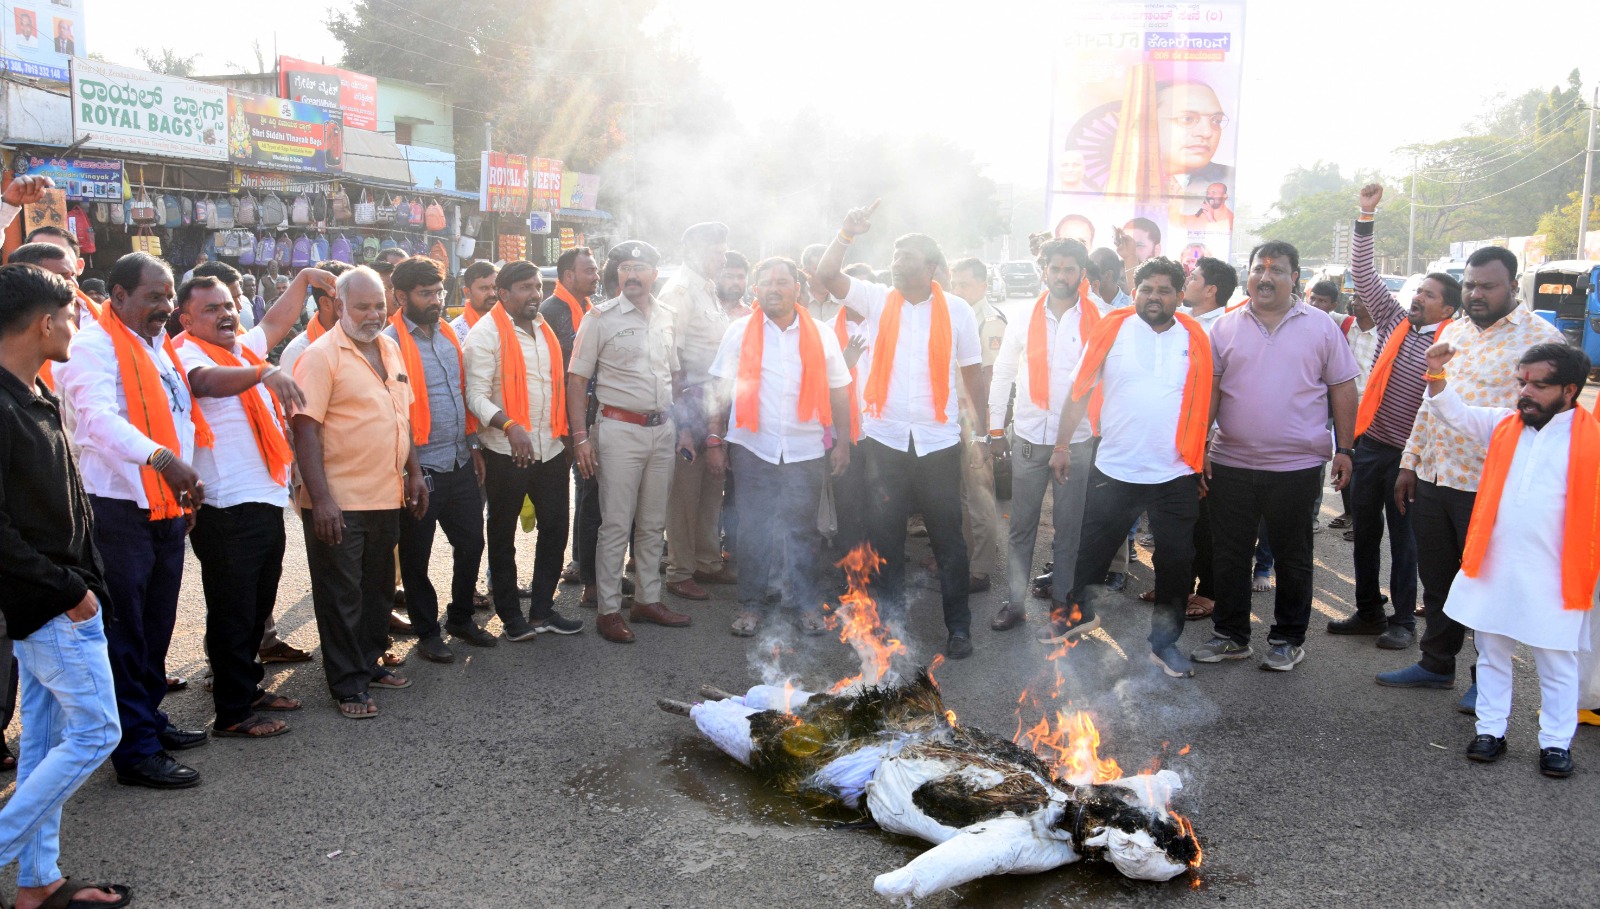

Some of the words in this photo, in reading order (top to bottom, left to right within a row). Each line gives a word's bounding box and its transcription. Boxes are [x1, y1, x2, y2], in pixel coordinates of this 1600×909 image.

[79, 79, 163, 109] ರಾಯಲ್
[81, 103, 141, 130] ROYAL
[148, 112, 193, 137] BAGS
[252, 128, 265, 138] Shri
[266, 129, 285, 141] Siddhi
[310, 137, 322, 147] Bags
[80, 172, 109, 181] Vinayak
[489, 166, 521, 186] ROYAL
